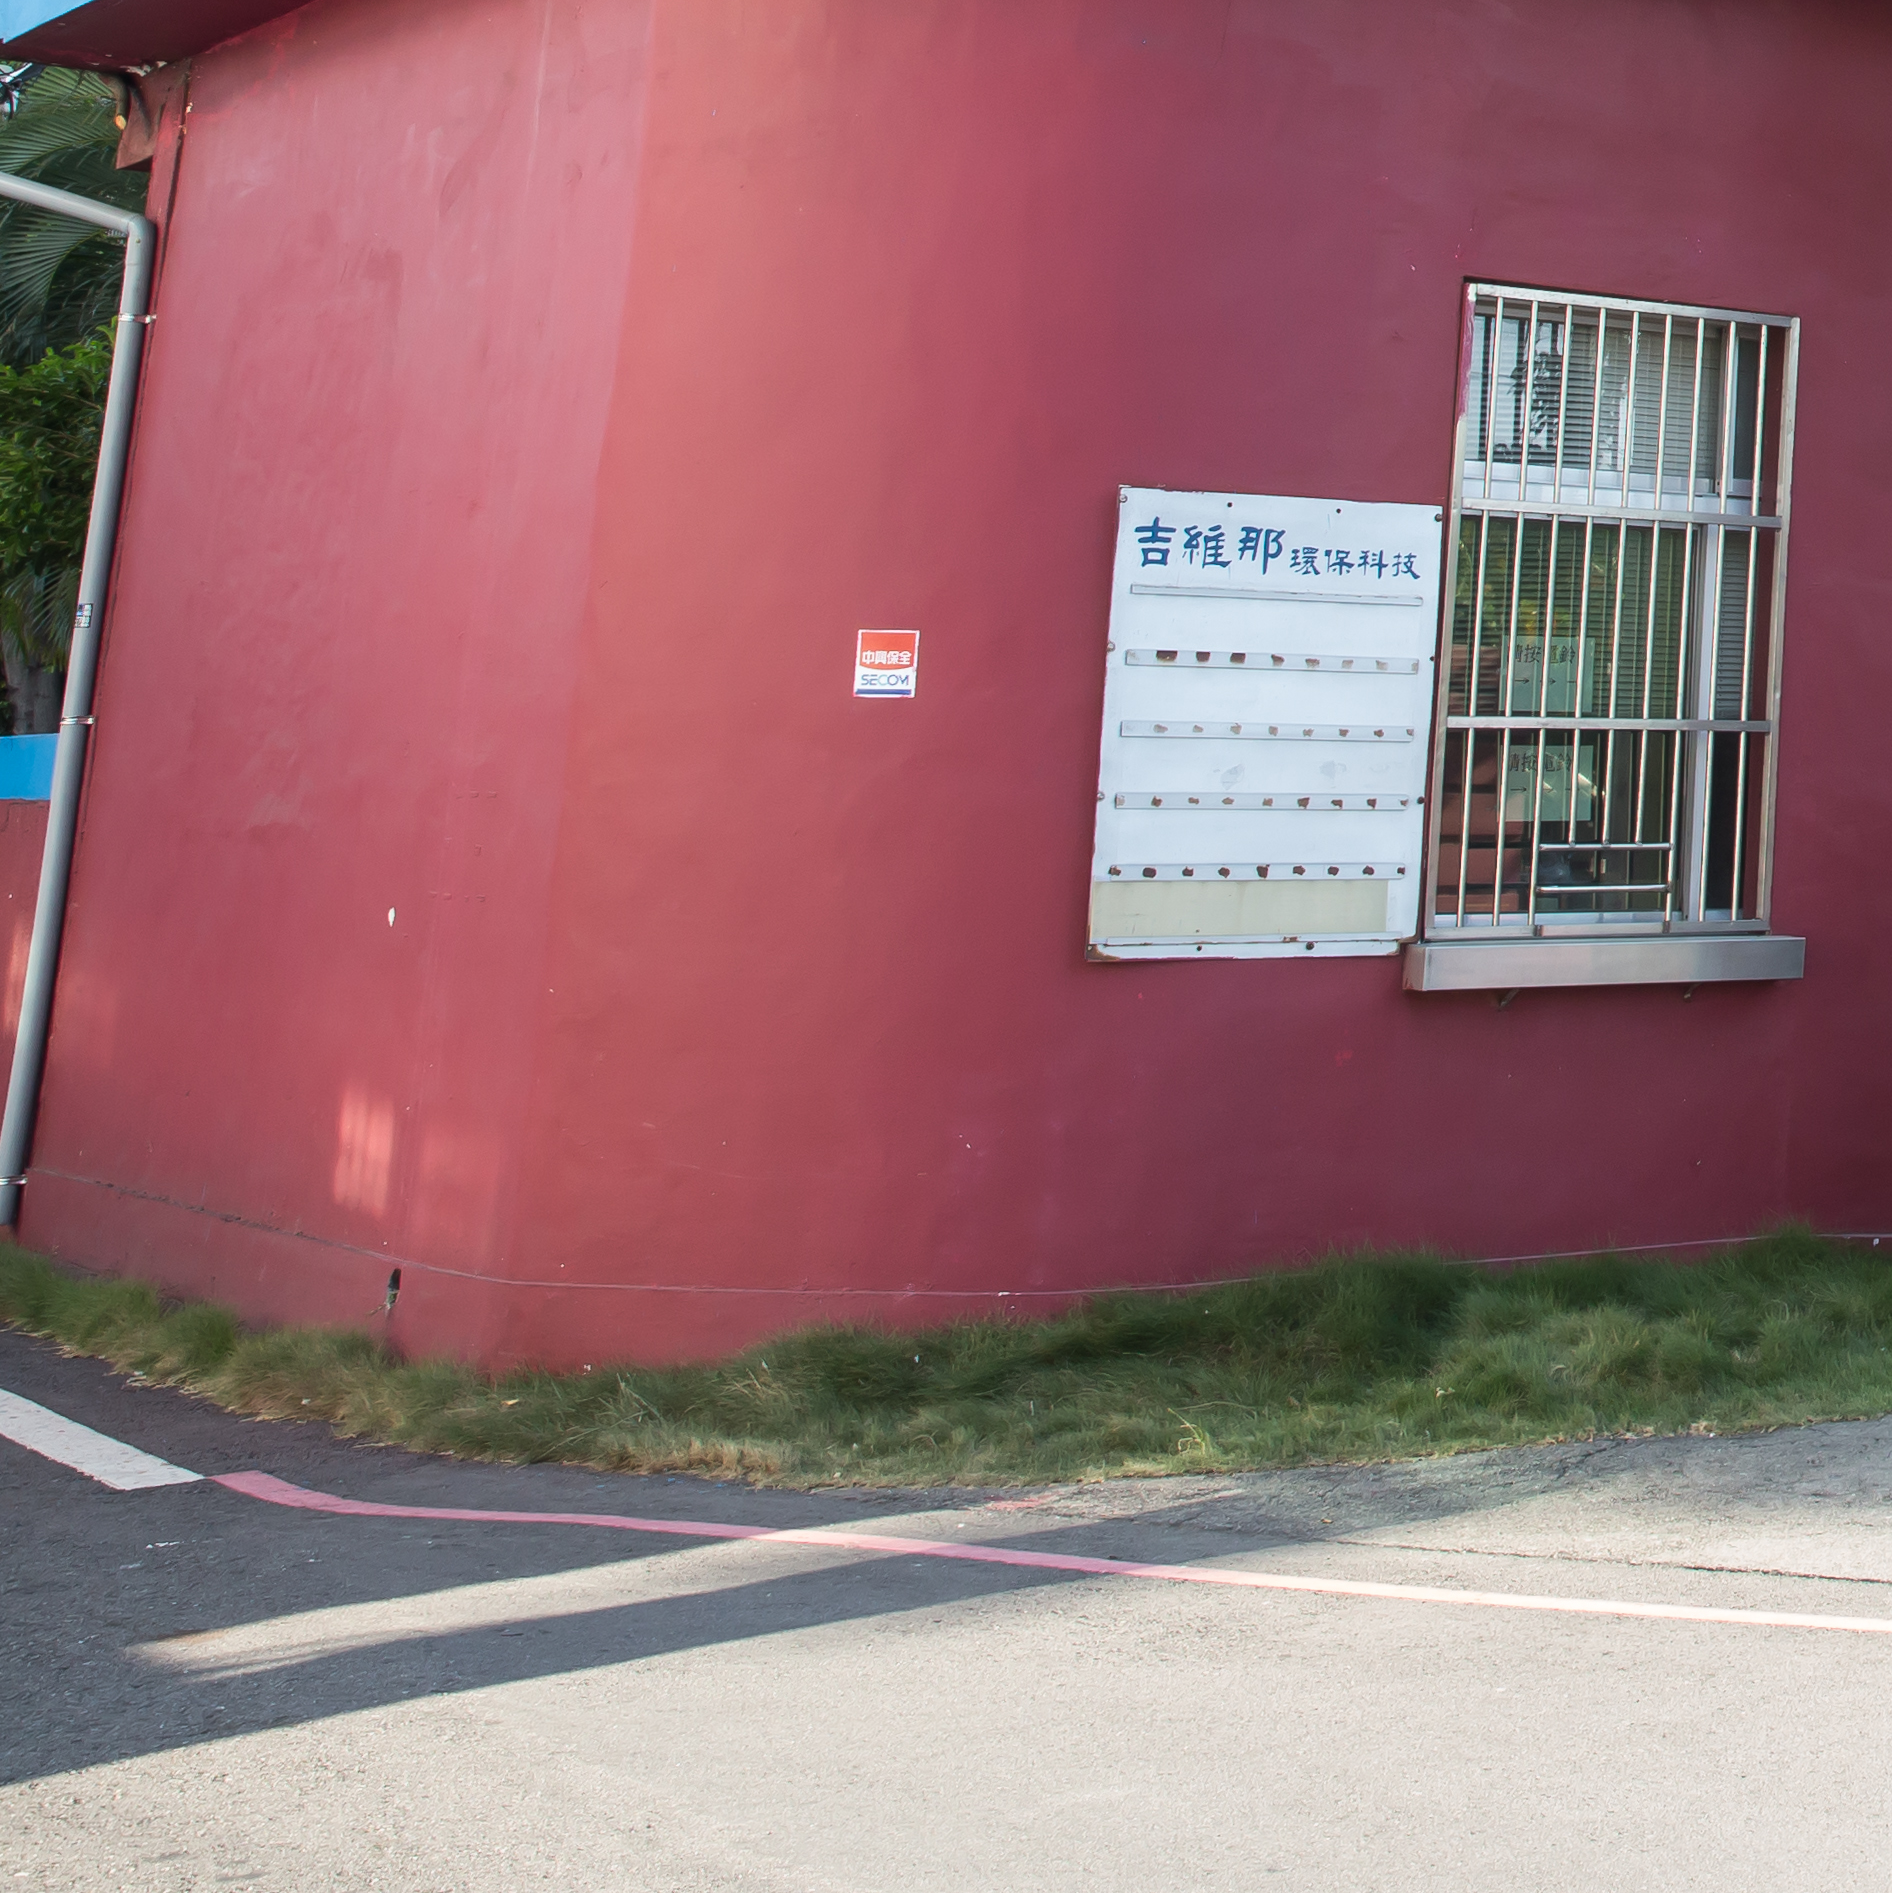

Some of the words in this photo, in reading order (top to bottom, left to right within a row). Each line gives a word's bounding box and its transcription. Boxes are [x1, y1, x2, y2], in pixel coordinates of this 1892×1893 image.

[862, 650, 912, 665] 中興保全
[861, 674, 910, 686] SECOM
